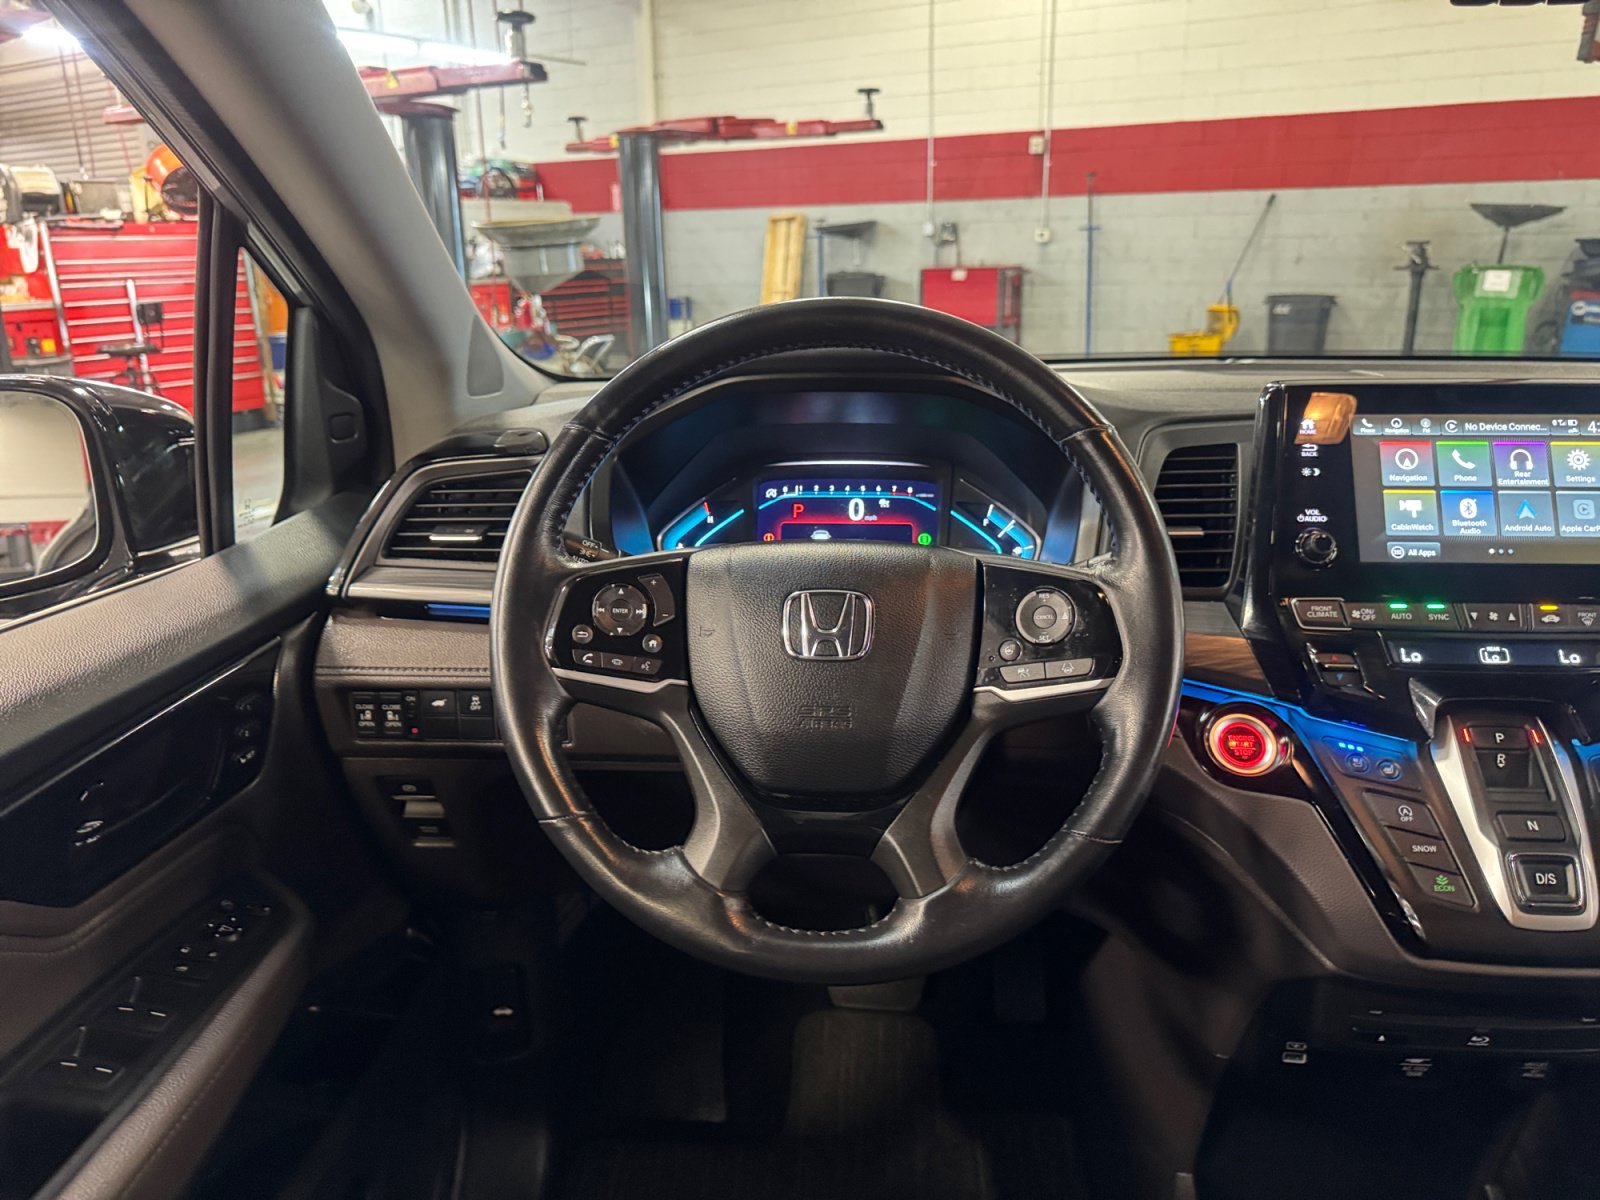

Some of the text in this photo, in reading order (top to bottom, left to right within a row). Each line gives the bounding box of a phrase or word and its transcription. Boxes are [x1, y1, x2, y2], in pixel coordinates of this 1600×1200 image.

[1465, 422, 1478, 431] No
[1480, 422, 1507, 431] Device
[1389, 474, 1428, 483] Navigation
[1454, 474, 1477, 482] Phone
[1514, 470, 1532, 478] Rear
[1498, 478, 1550, 486] Entertainment
[1566, 475, 1596, 483] Settings
[792, 503, 805, 518] P
[848, 497, 865, 521] 0
[1391, 523, 1434, 531] CabinWatch
[1452, 519, 1487, 527] Bluetooth
[1460, 527, 1481, 535] Audio
[1504, 524, 1552, 532] Android Auto
[1561, 525, 1582, 534] Apple
[582, 539, 596, 549] OFF
[1408, 548, 1436, 558] All Apps
[1362, 613, 1376, 621] OFF
[1391, 612, 1412, 620] AUTO
[1428, 613, 1450, 621] SYNC
[1400, 648, 1423, 663] Lo
[1558, 649, 1581, 664] Lo
[1495, 732, 1505, 744] P
[1496, 753, 1506, 764] R
[1527, 820, 1539, 832] N
[1411, 844, 1437, 853] SNOW
[1535, 873, 1557, 885] D/S
[1433, 884, 1455, 893] ECON
